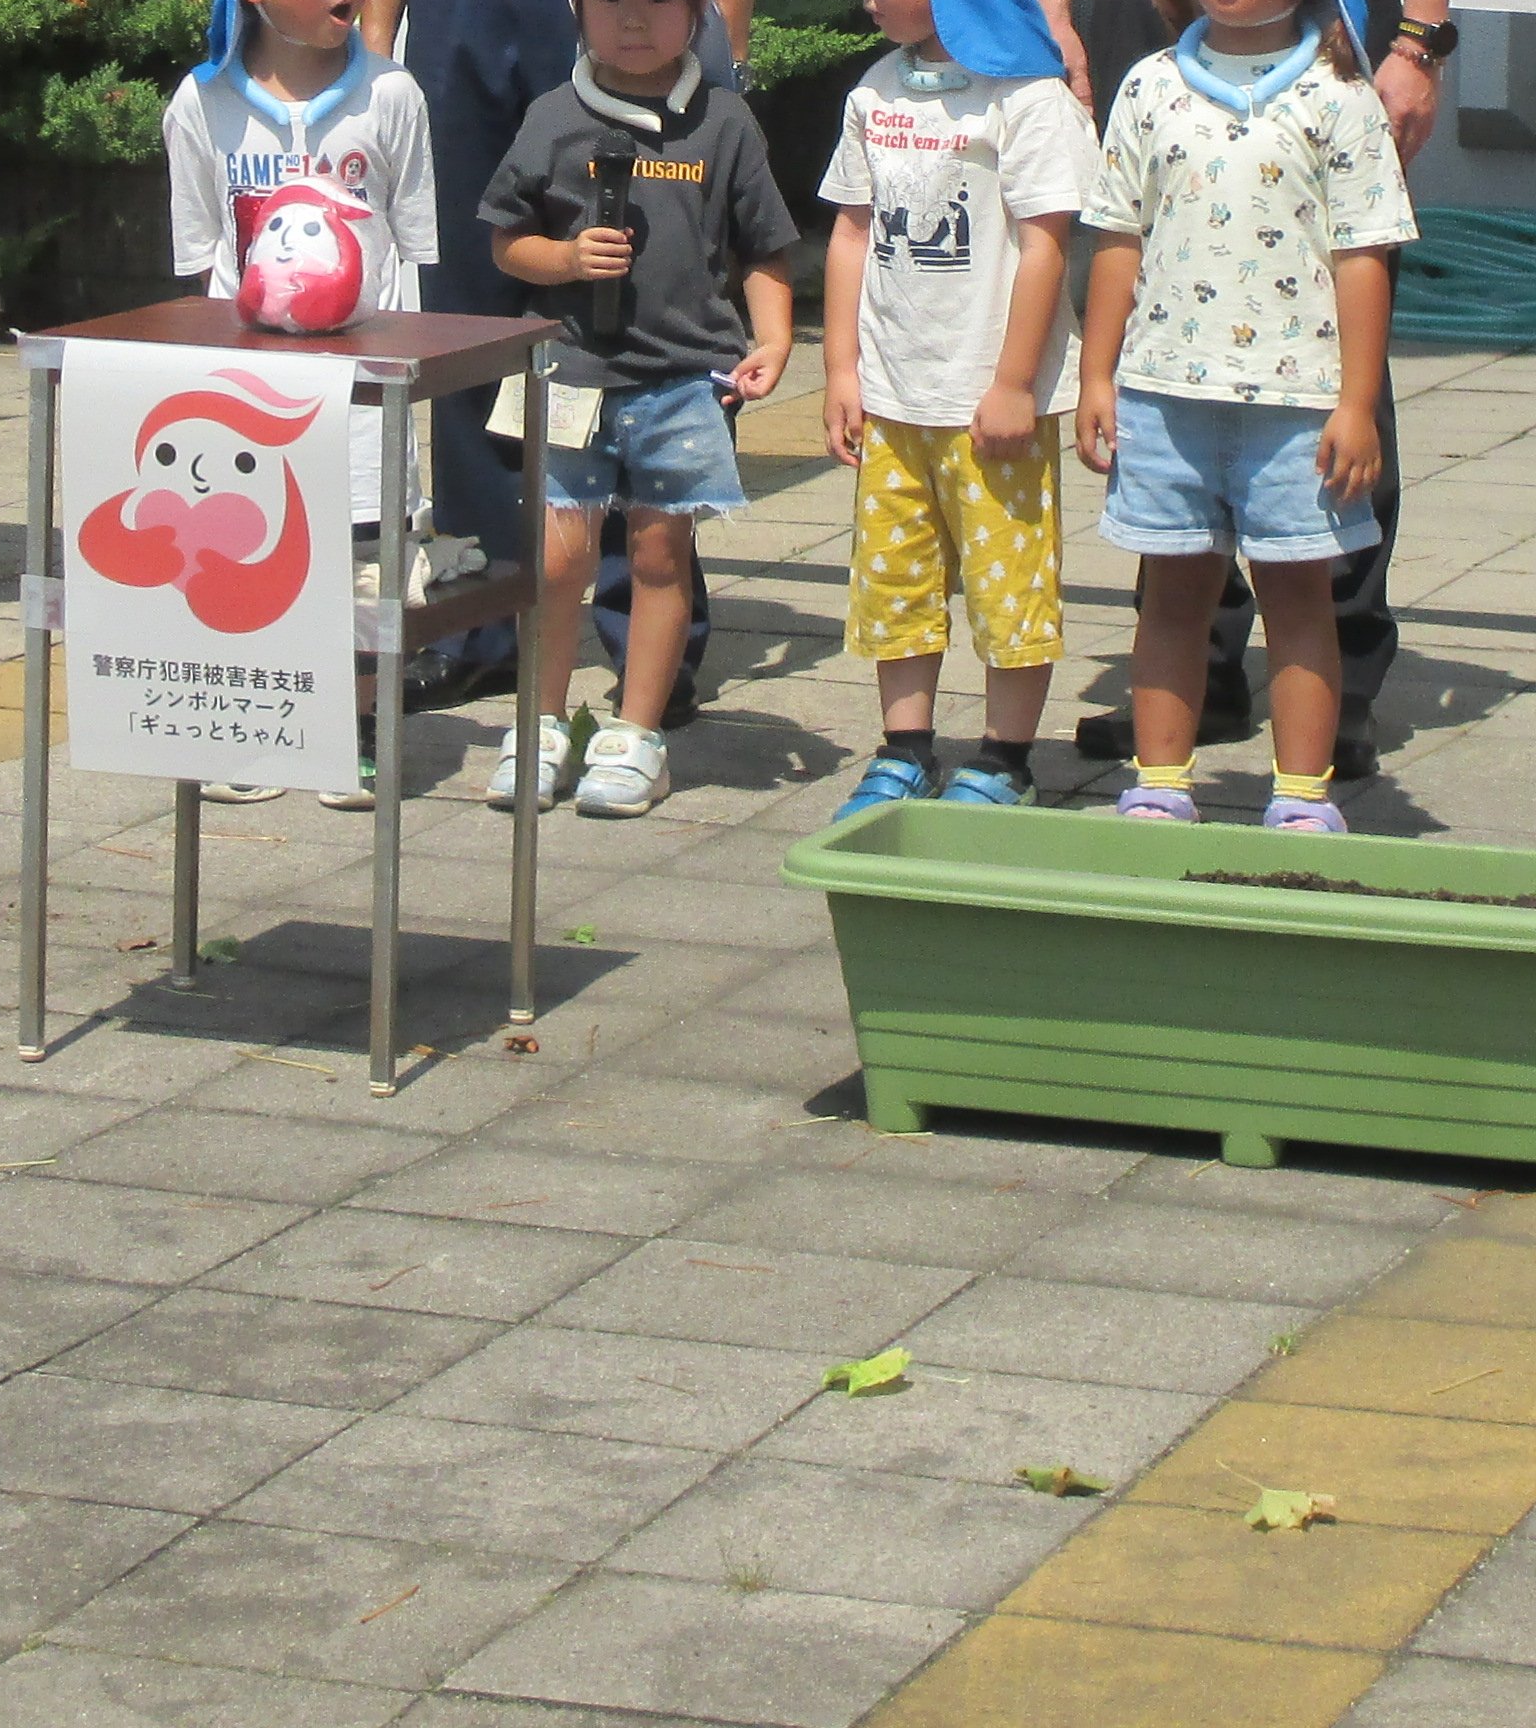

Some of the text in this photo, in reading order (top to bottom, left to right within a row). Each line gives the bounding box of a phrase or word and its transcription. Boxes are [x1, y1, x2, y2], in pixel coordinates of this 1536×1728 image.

[871, 109, 915, 128] Gotta
[226, 153, 284, 186] GAME
[587, 155, 705, 184] fusand
[92, 653, 315, 694] 警察庁犯罪被害者支援
[143, 687, 296, 719] シンボルマーク
[129, 711, 305, 750] 「ギュっとちゃん」
